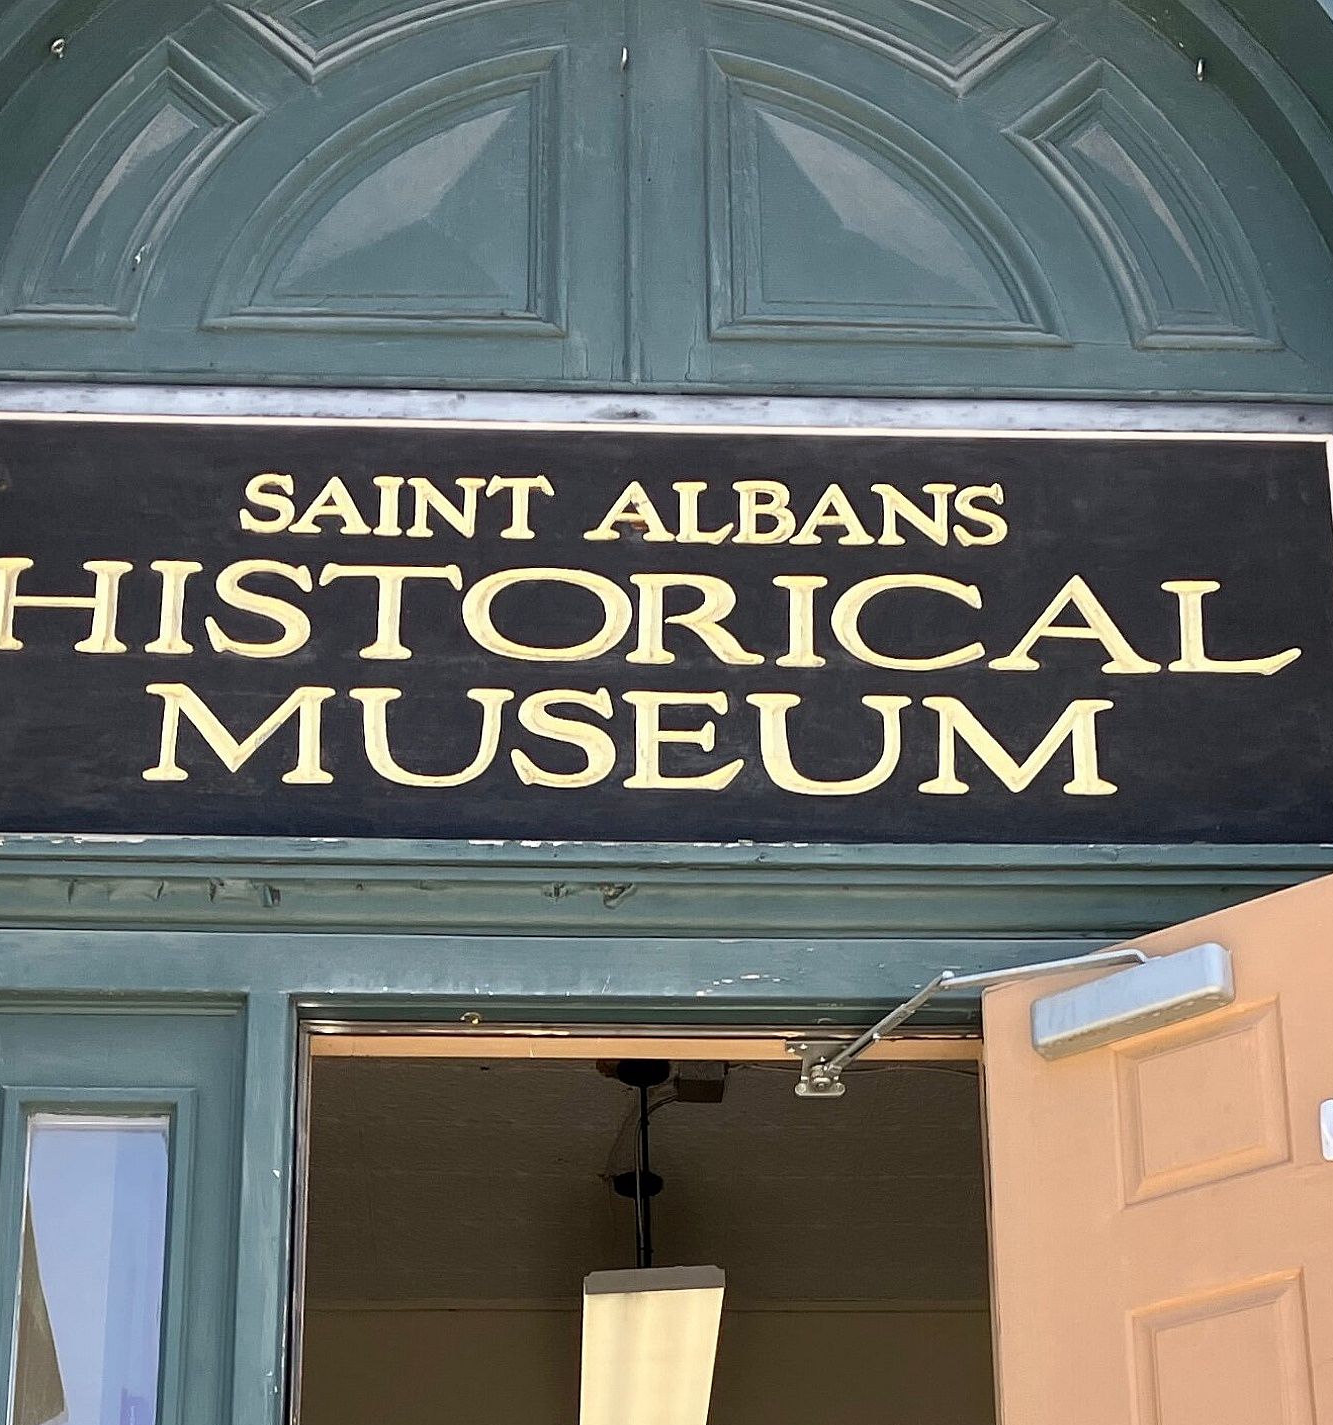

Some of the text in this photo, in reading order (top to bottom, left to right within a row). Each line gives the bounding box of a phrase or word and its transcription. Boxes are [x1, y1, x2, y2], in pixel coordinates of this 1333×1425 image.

[240, 473, 1008, 547] SAINT ALBANS
[143, 683, 1117, 795] MUSEUM
